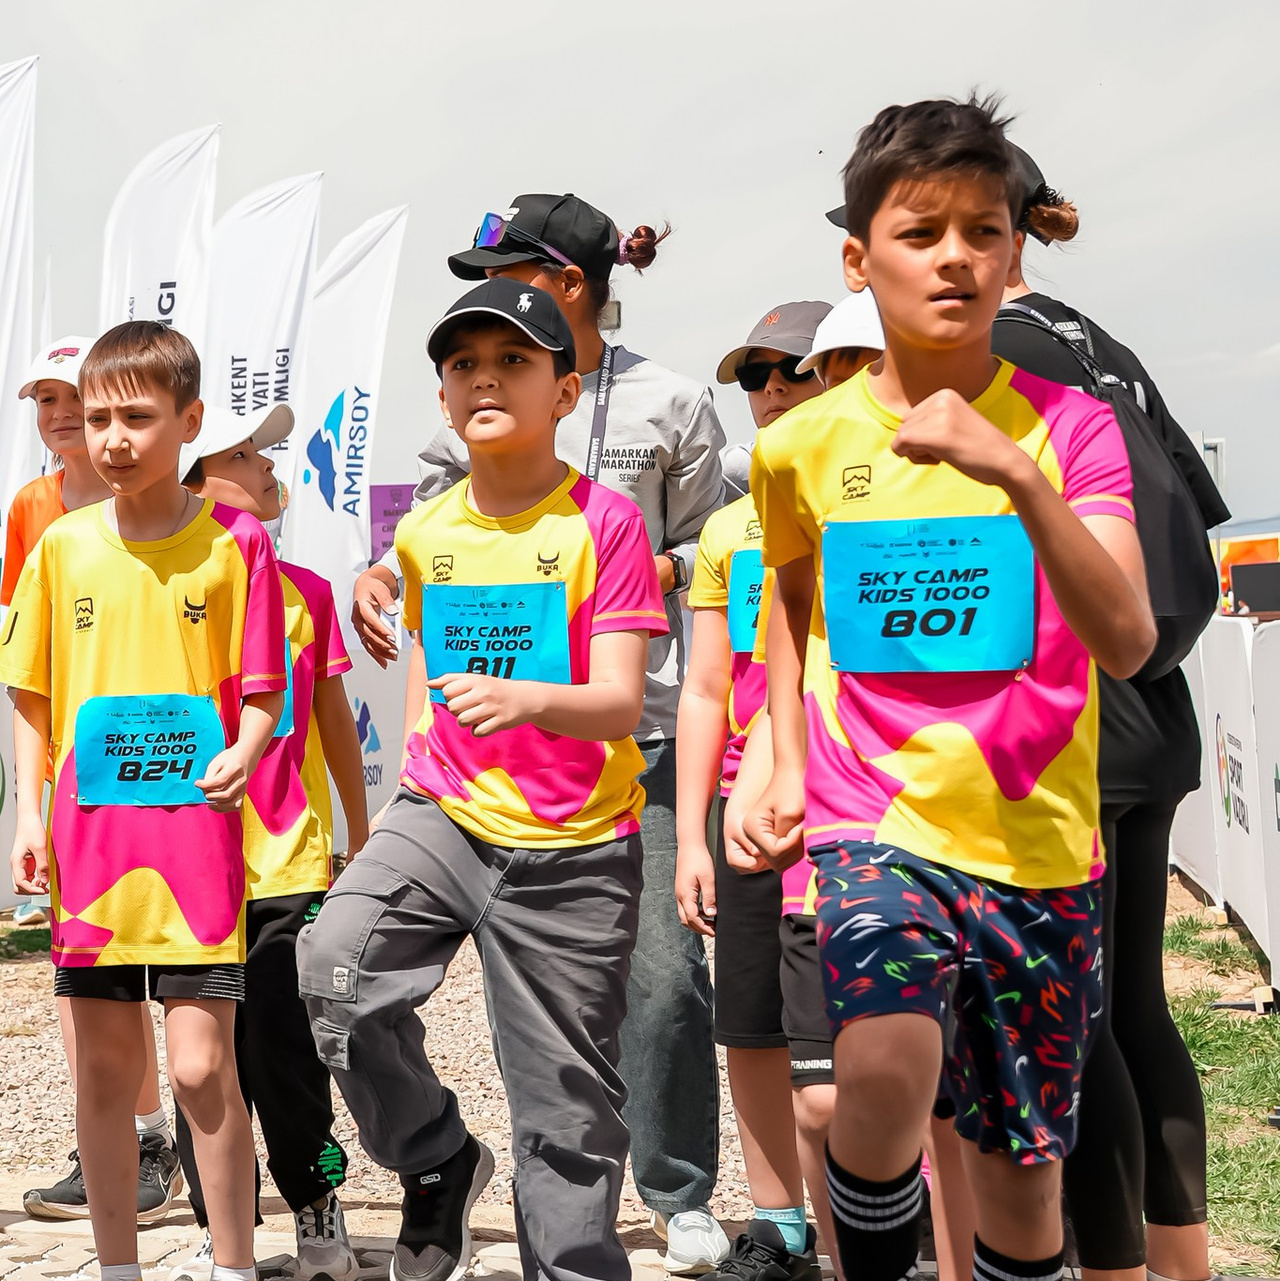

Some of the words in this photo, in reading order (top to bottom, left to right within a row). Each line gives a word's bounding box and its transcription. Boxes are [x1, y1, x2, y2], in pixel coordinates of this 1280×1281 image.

[231, 355, 247, 416] HKENT
[252, 372, 269, 412] YATI
[342, 386, 371, 517] AMIRSOY
[600, 448, 658, 459] AMARKAN
[601, 459, 657, 470] MARATHON
[537, 564, 558, 572] BUKA
[857, 571, 908, 587] SKY
[914, 568, 988, 584] CAMP
[858, 588, 916, 604] KIDS
[924, 586, 990, 602] 1000
[881, 607, 978, 638] 801
[444, 626, 476, 637] SKY
[478, 625, 532, 638] CAMP
[444, 640, 480, 651] KIDS
[485, 639, 533, 651] 1000
[105, 733, 140, 745] SKY
[144, 731, 196, 744] CAMP
[105, 744, 146, 757] KIDS
[151, 744, 197, 757] 1000
[117, 759, 194, 782] 824
